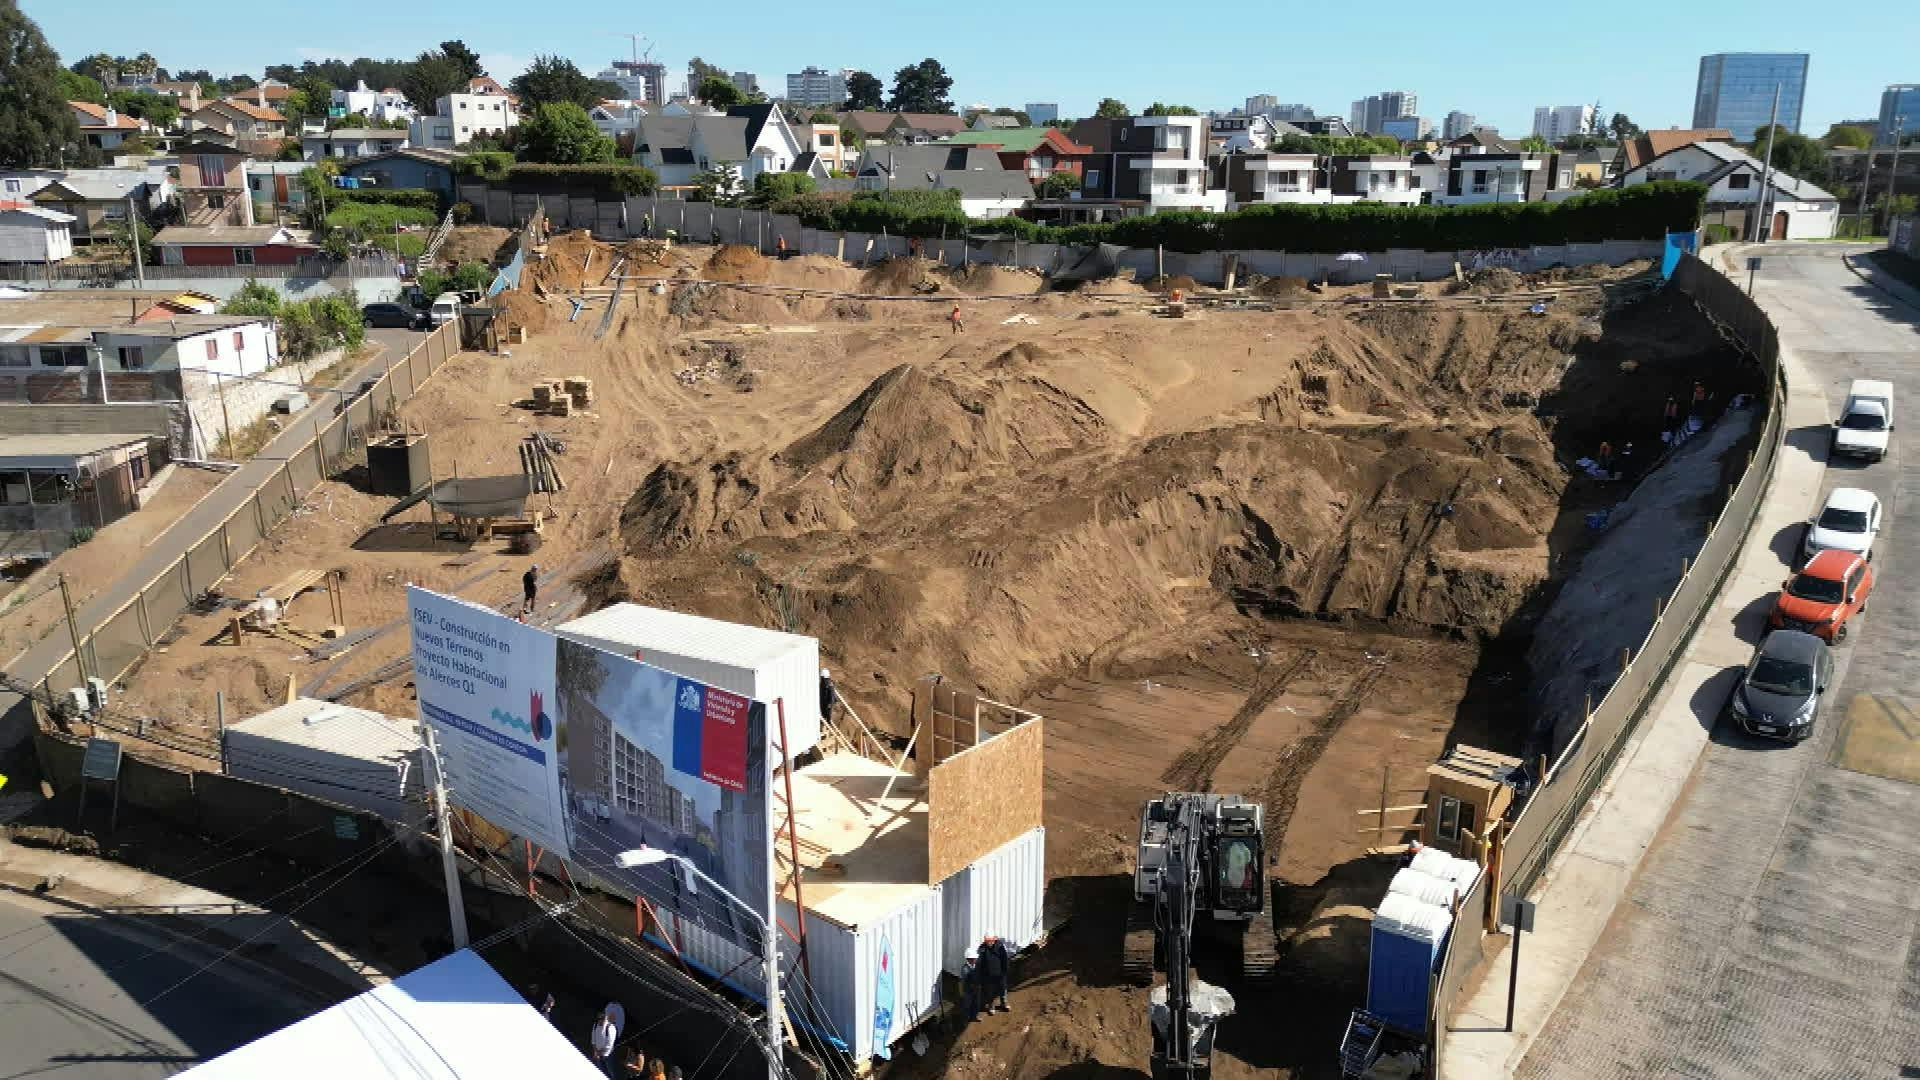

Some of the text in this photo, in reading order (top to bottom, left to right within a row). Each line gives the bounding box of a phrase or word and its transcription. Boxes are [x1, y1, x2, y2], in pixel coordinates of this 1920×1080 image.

[415, 624, 484, 662] Nuevos Terrenos
[440, 617, 497, 649] Construcción
[499, 641, 510, 654] en
[416, 643, 507, 689] Proyecto Habitacional
[429, 667, 461, 688] Alerces
